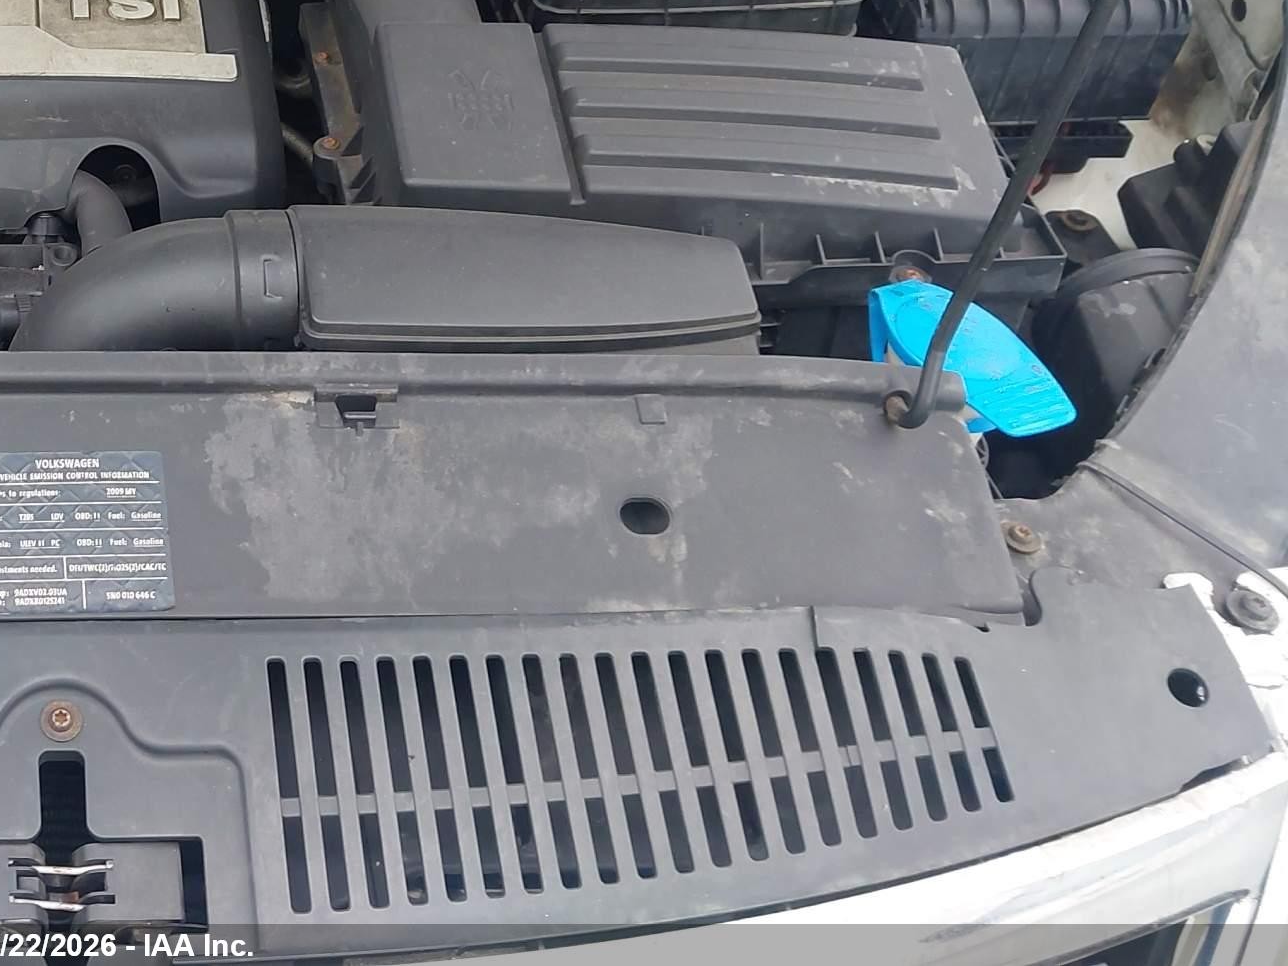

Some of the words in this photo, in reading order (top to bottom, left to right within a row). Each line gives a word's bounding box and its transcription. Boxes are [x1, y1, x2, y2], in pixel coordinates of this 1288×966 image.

[35, 458, 100, 469] VOLKSWAGEN
[0, 472, 28, 481] VEHICLE
[30, 472, 64, 481] EMISSION
[65, 471, 98, 480] CONTROL
[100, 471, 150, 480] INFORMATION
[106, 487, 124, 495] 2009
[50, 512, 64, 520] LDV
[108, 511, 126, 520] Fuel:
[131, 511, 162, 519] Gasoline
[19, 539, 36, 547] ULEV
[50, 538, 61, 547] PC
[109, 537, 127, 546] Fuel:
[133, 537, 164, 545] Gasoline
[30, 564, 58, 573] needed.
[150, 590, 156, 599] C
